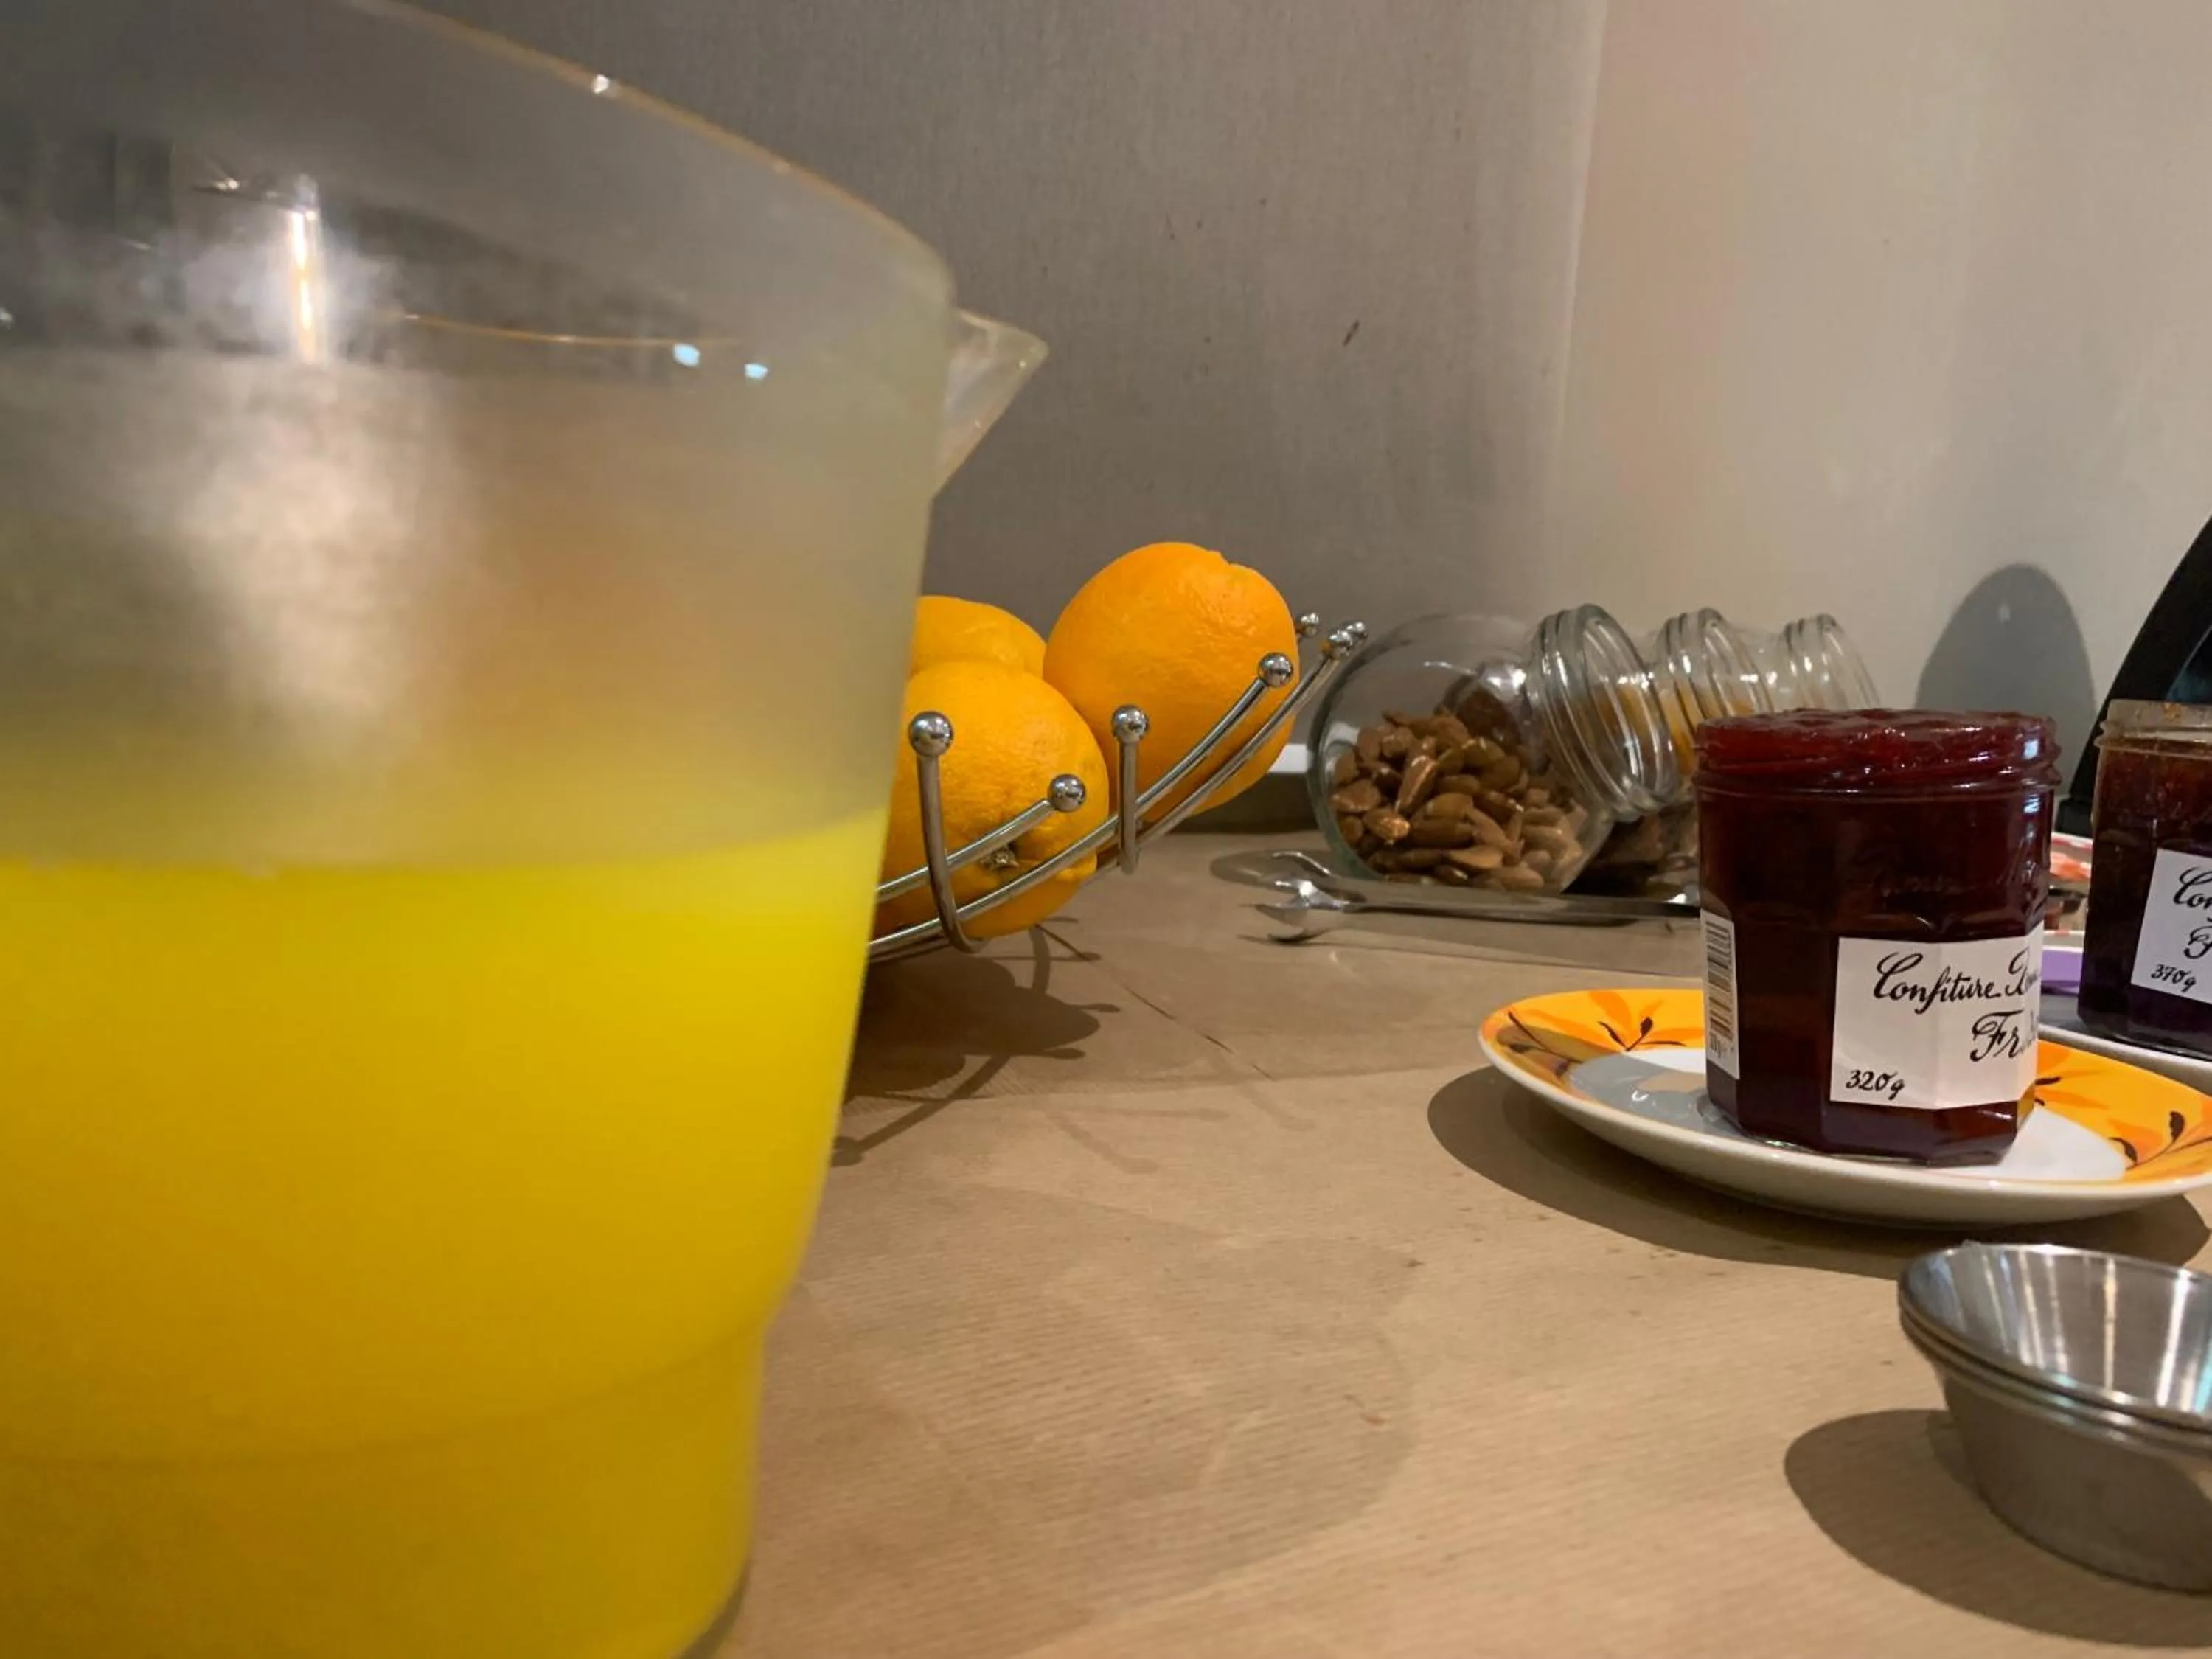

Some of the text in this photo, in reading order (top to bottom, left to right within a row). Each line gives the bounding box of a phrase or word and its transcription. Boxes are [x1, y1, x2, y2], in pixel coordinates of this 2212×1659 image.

[1874, 951, 2001, 1015] Confiture
[2151, 964, 2196, 992] 370g
[1846, 1069, 1905, 1101] 320g
